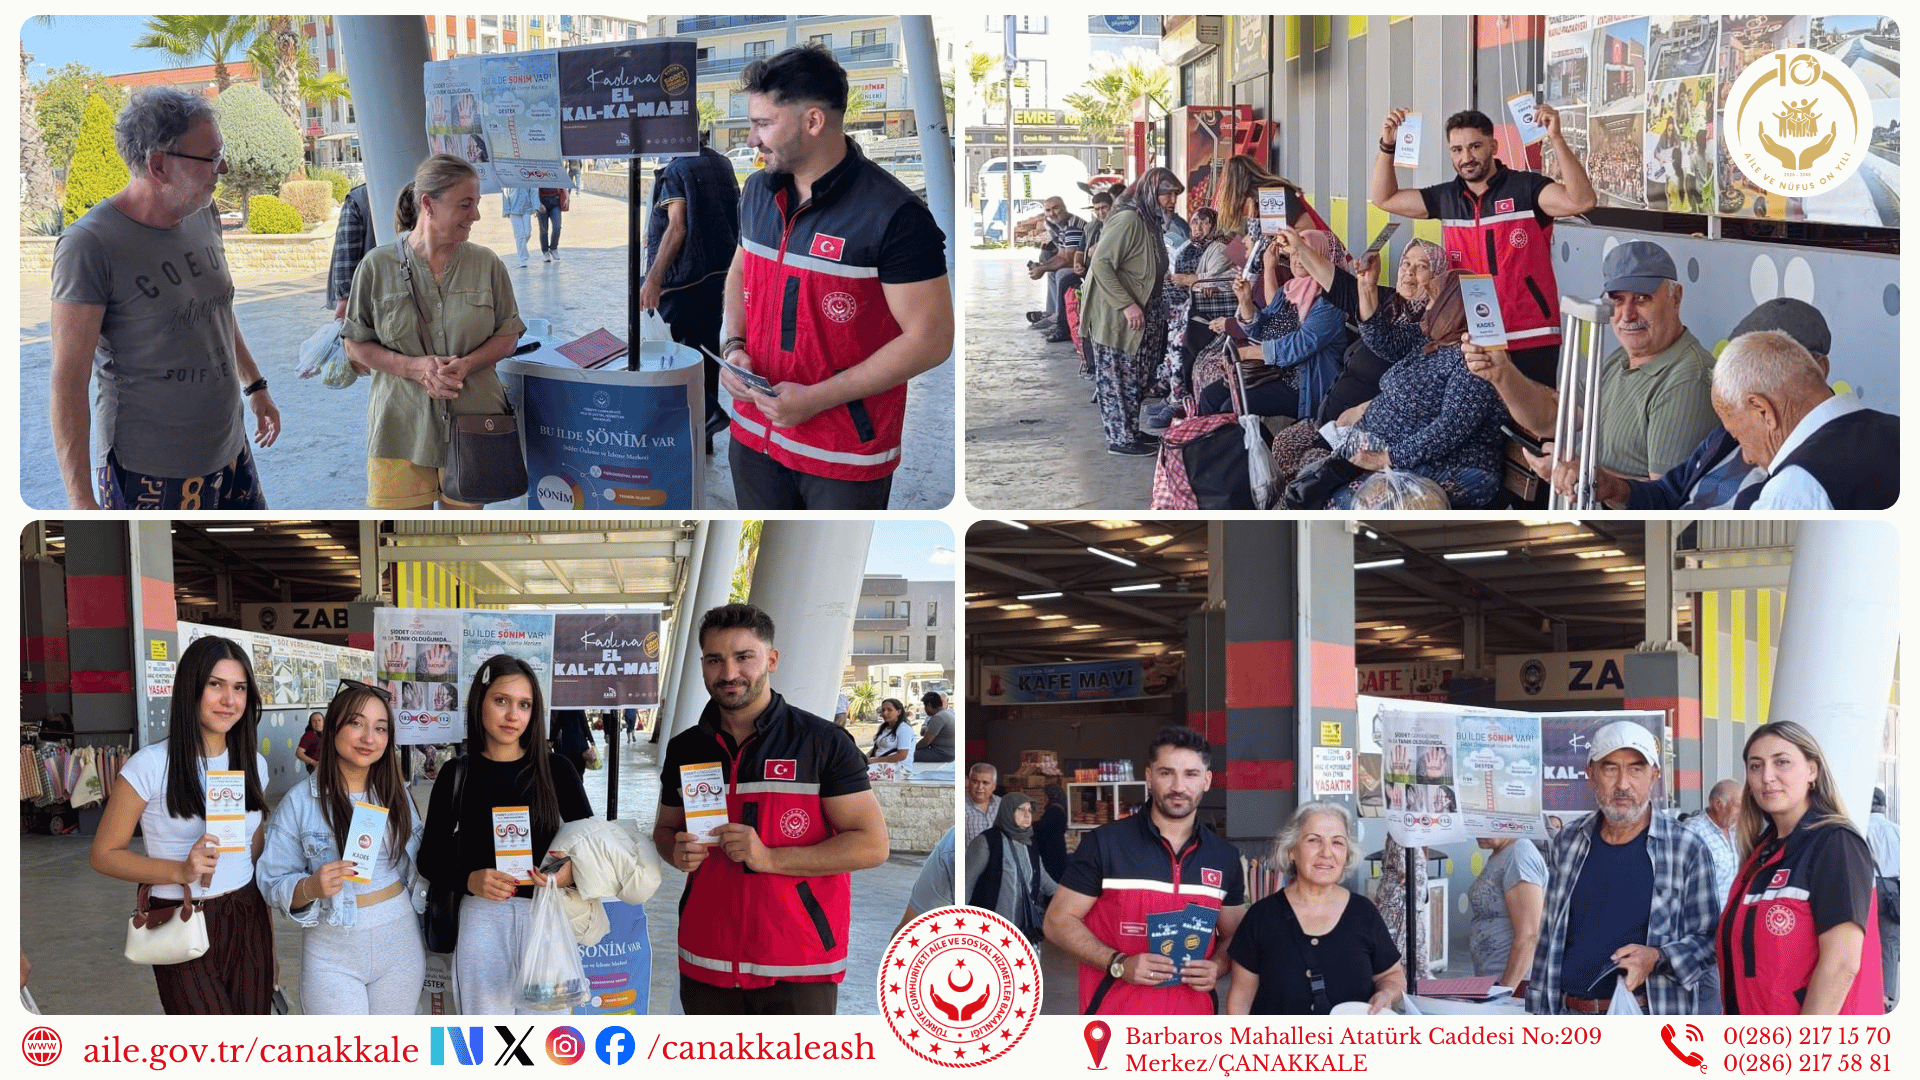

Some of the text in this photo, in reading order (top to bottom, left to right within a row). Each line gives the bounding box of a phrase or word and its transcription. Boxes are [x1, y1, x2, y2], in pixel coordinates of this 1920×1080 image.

[612, 88, 634, 102] EL
[562, 100, 689, 121] KAL-KA-MAZ!
[1014, 111, 1056, 124] EMRE
[164, 368, 207, 383] SOIF
[540, 425, 676, 448] BU İLDE ŞÖNİM VAR
[538, 487, 574, 504] ŞÖNİM
[463, 629, 475, 637] BU
[477, 629, 496, 638] İLDE
[527, 631, 547, 639] VAR!
[602, 649, 621, 662] EL
[1018, 668, 1133, 690] KAFE MAVİ
[1456, 732, 1467, 740] BU
[1468, 731, 1486, 741] İLDE
[1315, 780, 1351, 791] YASAKTIR
[627, 941, 642, 952] VAR
[423, 980, 445, 989] ESTEK
